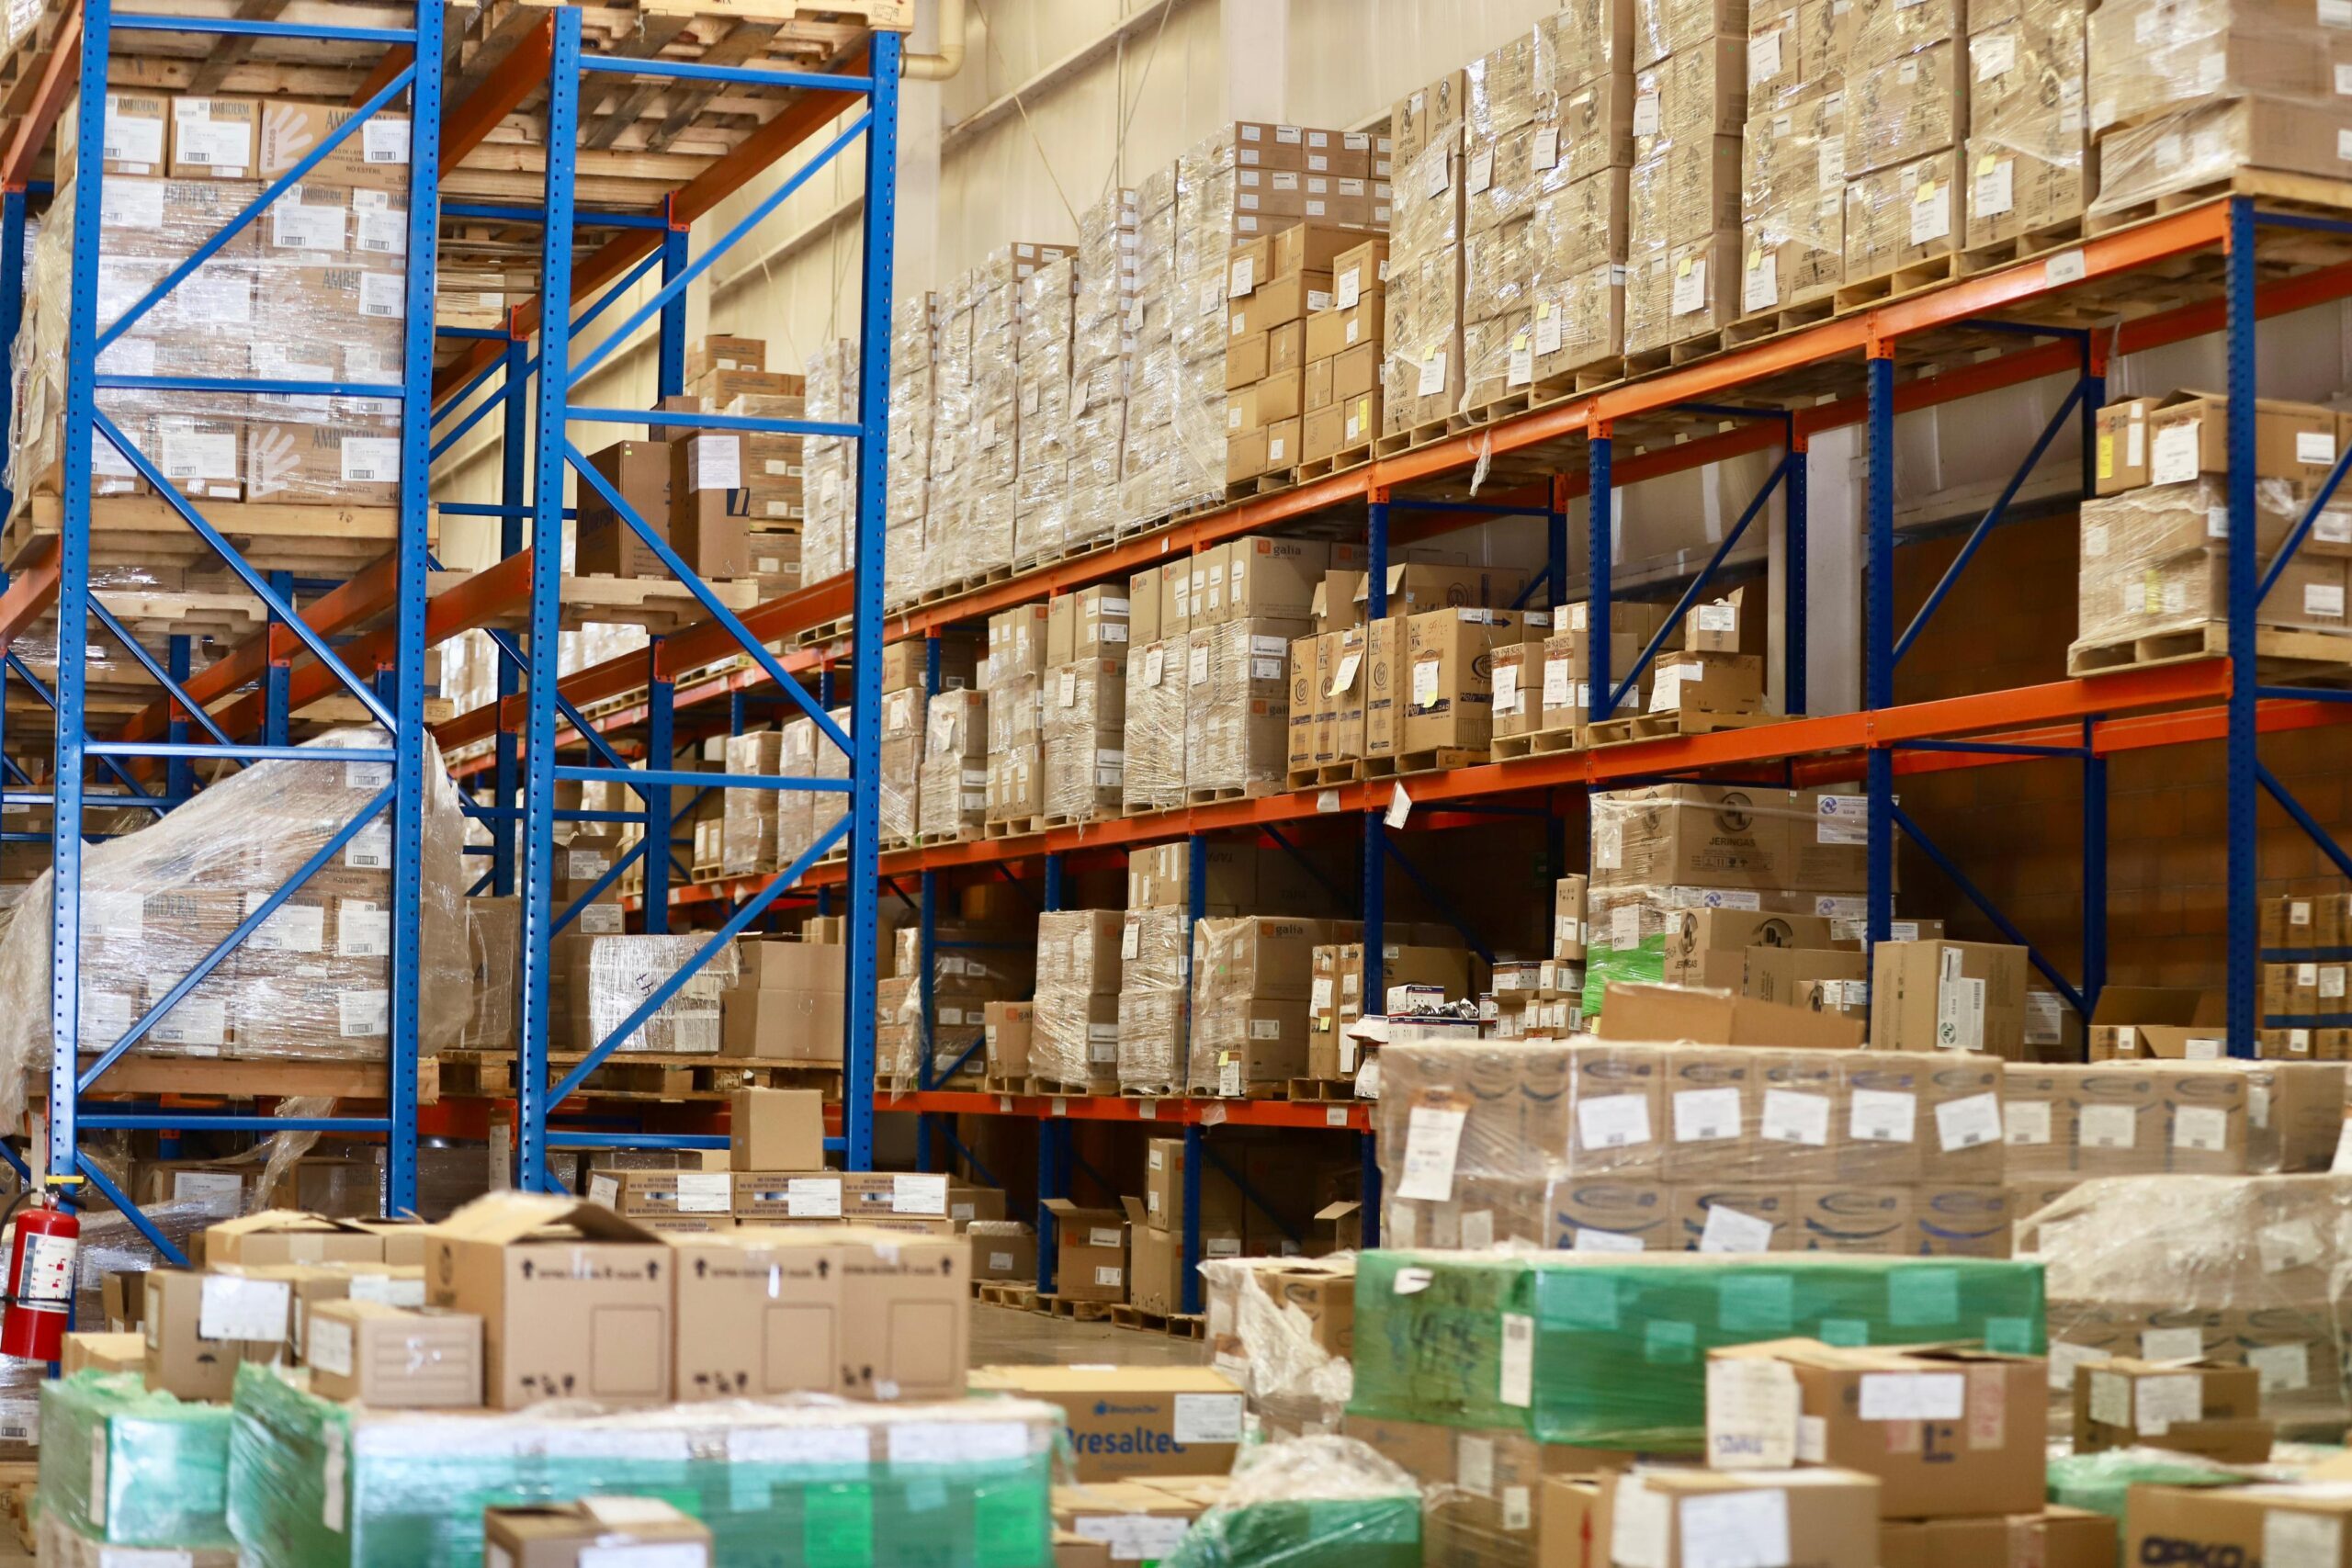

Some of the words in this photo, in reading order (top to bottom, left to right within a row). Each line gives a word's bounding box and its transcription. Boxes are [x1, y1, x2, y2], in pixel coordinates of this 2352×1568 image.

[118, 97, 159, 113] AMBIDERM
[209, 102, 250, 115] AMBIDERM
[1273, 544, 1301, 557] galia
[1709, 837, 1756, 848] JERINGAS
[1275, 923, 1303, 936] galia
